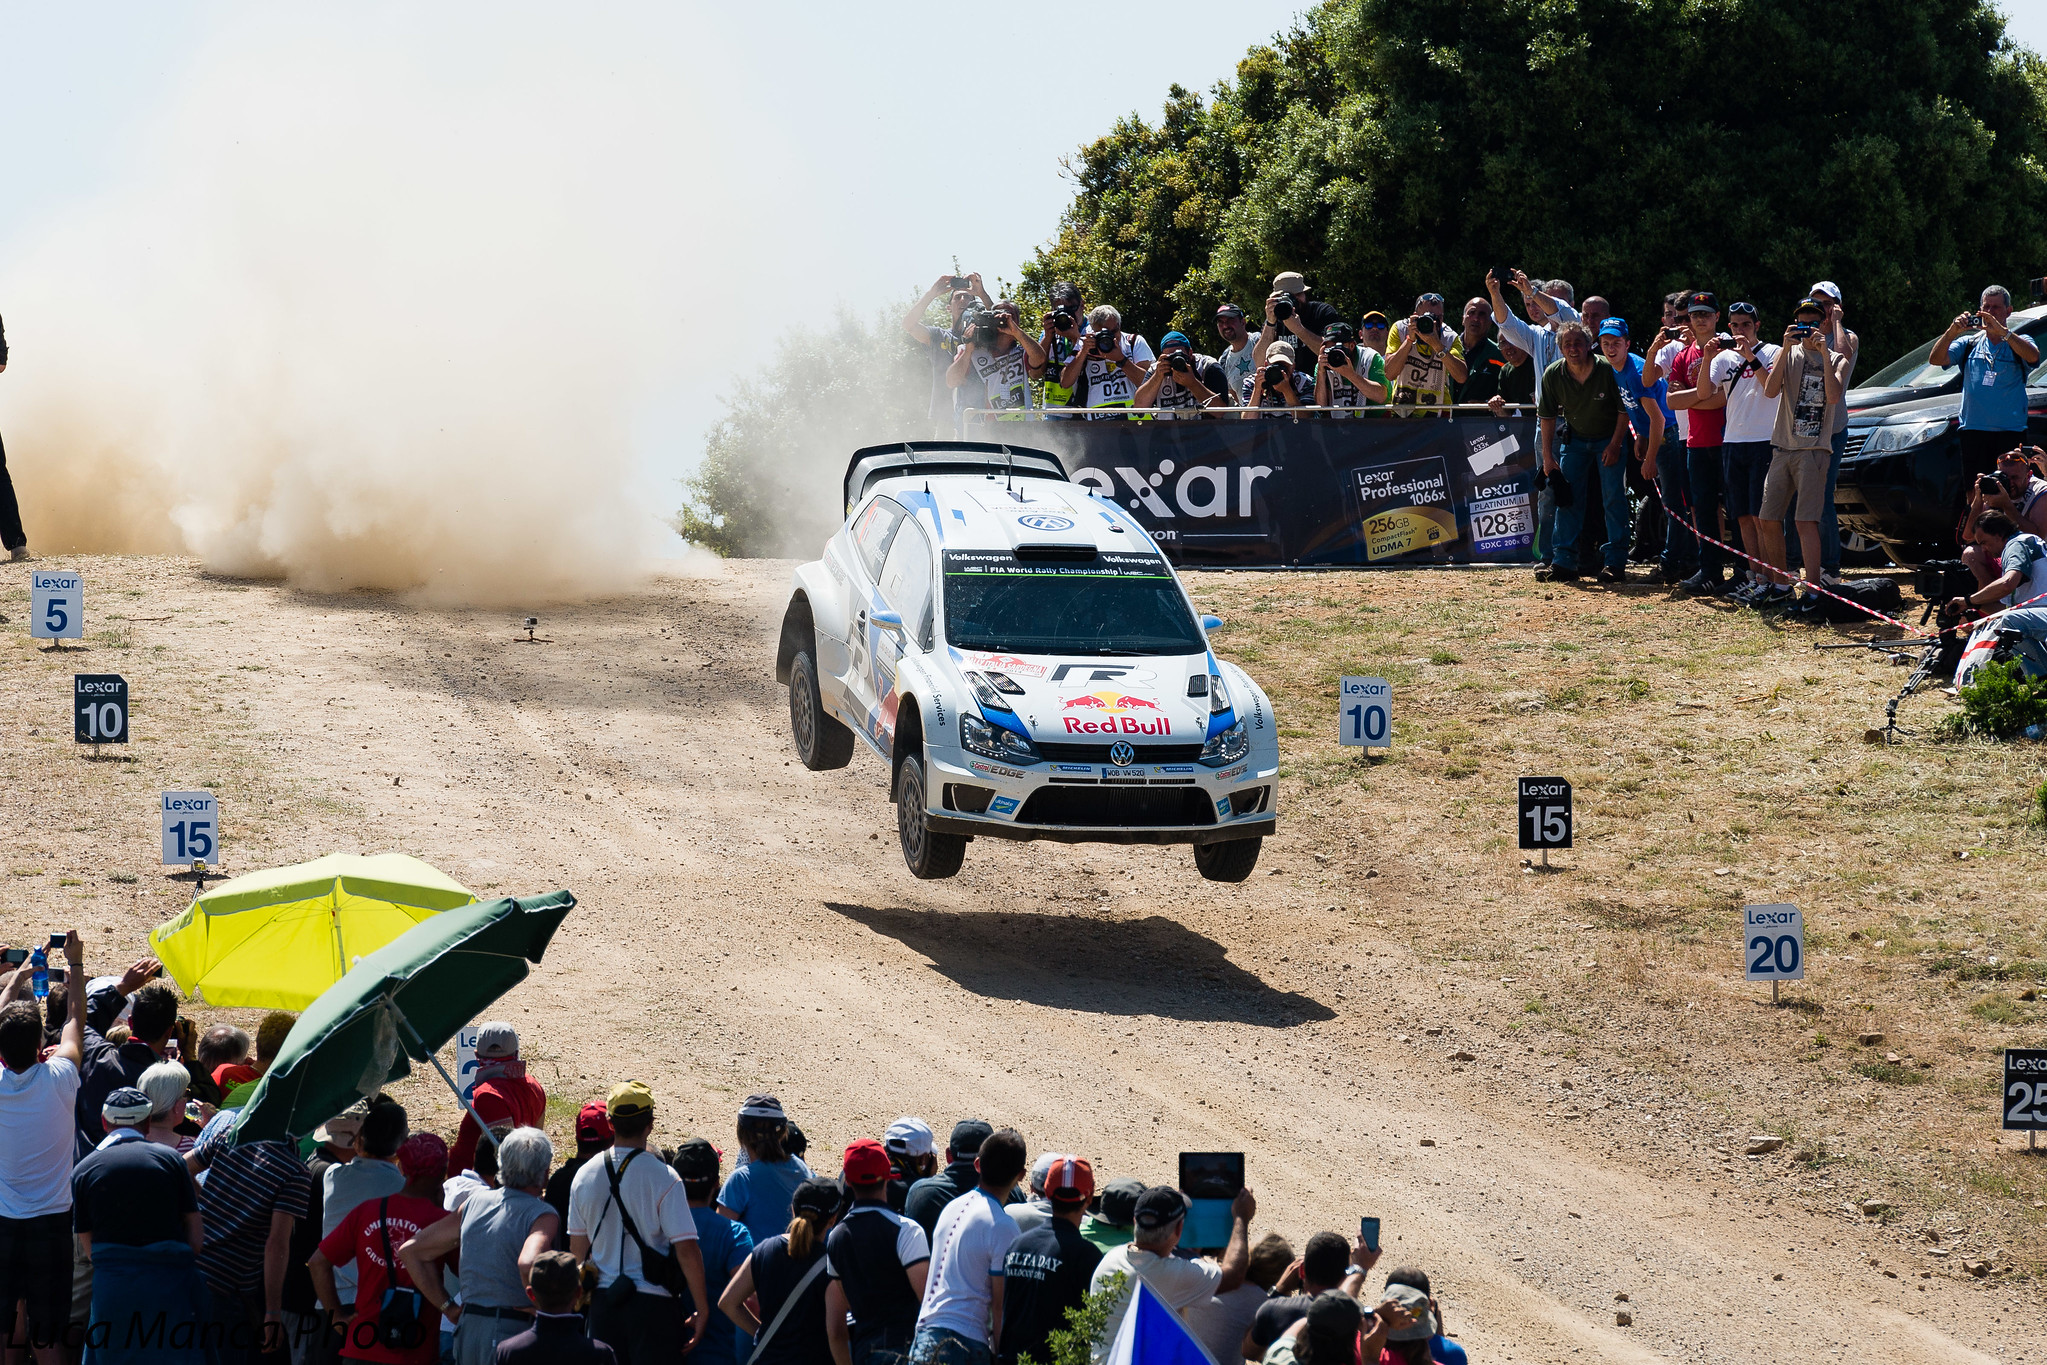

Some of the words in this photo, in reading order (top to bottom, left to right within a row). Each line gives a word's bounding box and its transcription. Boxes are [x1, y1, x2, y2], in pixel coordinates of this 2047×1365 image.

[1103, 381, 1128, 396] 021
[1469, 434, 1487, 446] Lexar
[1473, 441, 1490, 453] 633x
[1357, 470, 1395, 486] Lexar
[1069, 459, 1273, 518] exar
[1360, 474, 1444, 501] Professional
[1474, 482, 1520, 499] Lexar
[1410, 490, 1447, 506] 1066x
[1474, 498, 1517, 511] PLATINUM
[1372, 540, 1405, 555] UDMA
[1405, 538, 1412, 547] 7
[1480, 540, 1502, 550] SDXC
[948, 553, 1013, 562] Volkswagen
[1102, 555, 1162, 565] Volkswagen
[1035, 567, 1057, 575] Rally
[1059, 568, 1118, 576] Championship
[35, 575, 77, 589] Lexar
[45, 598, 68, 632] 5
[78, 679, 122, 693] Lexar
[1344, 680, 1387, 695] Lexar
[932, 693, 946, 727] Services
[81, 702, 123, 738] 10
[1062, 716, 1118, 734] Red
[1120, 717, 1172, 736] Bull
[1347, 704, 1386, 740] 10
[990, 766, 1027, 779] EDGE
[1107, 768, 1120, 777] WOB
[1522, 782, 1566, 795] Lexar
[165, 796, 211, 811] Lexar
[1525, 805, 1567, 843] 15
[169, 820, 213, 858] 15
[1748, 910, 1796, 925] Lexar
[1749, 934, 1800, 974] 20
[2009, 1054, 2047, 1071] Lexa
[2007, 1081, 2047, 1123] 25
[1037, 1254, 1063, 1273] DAY
